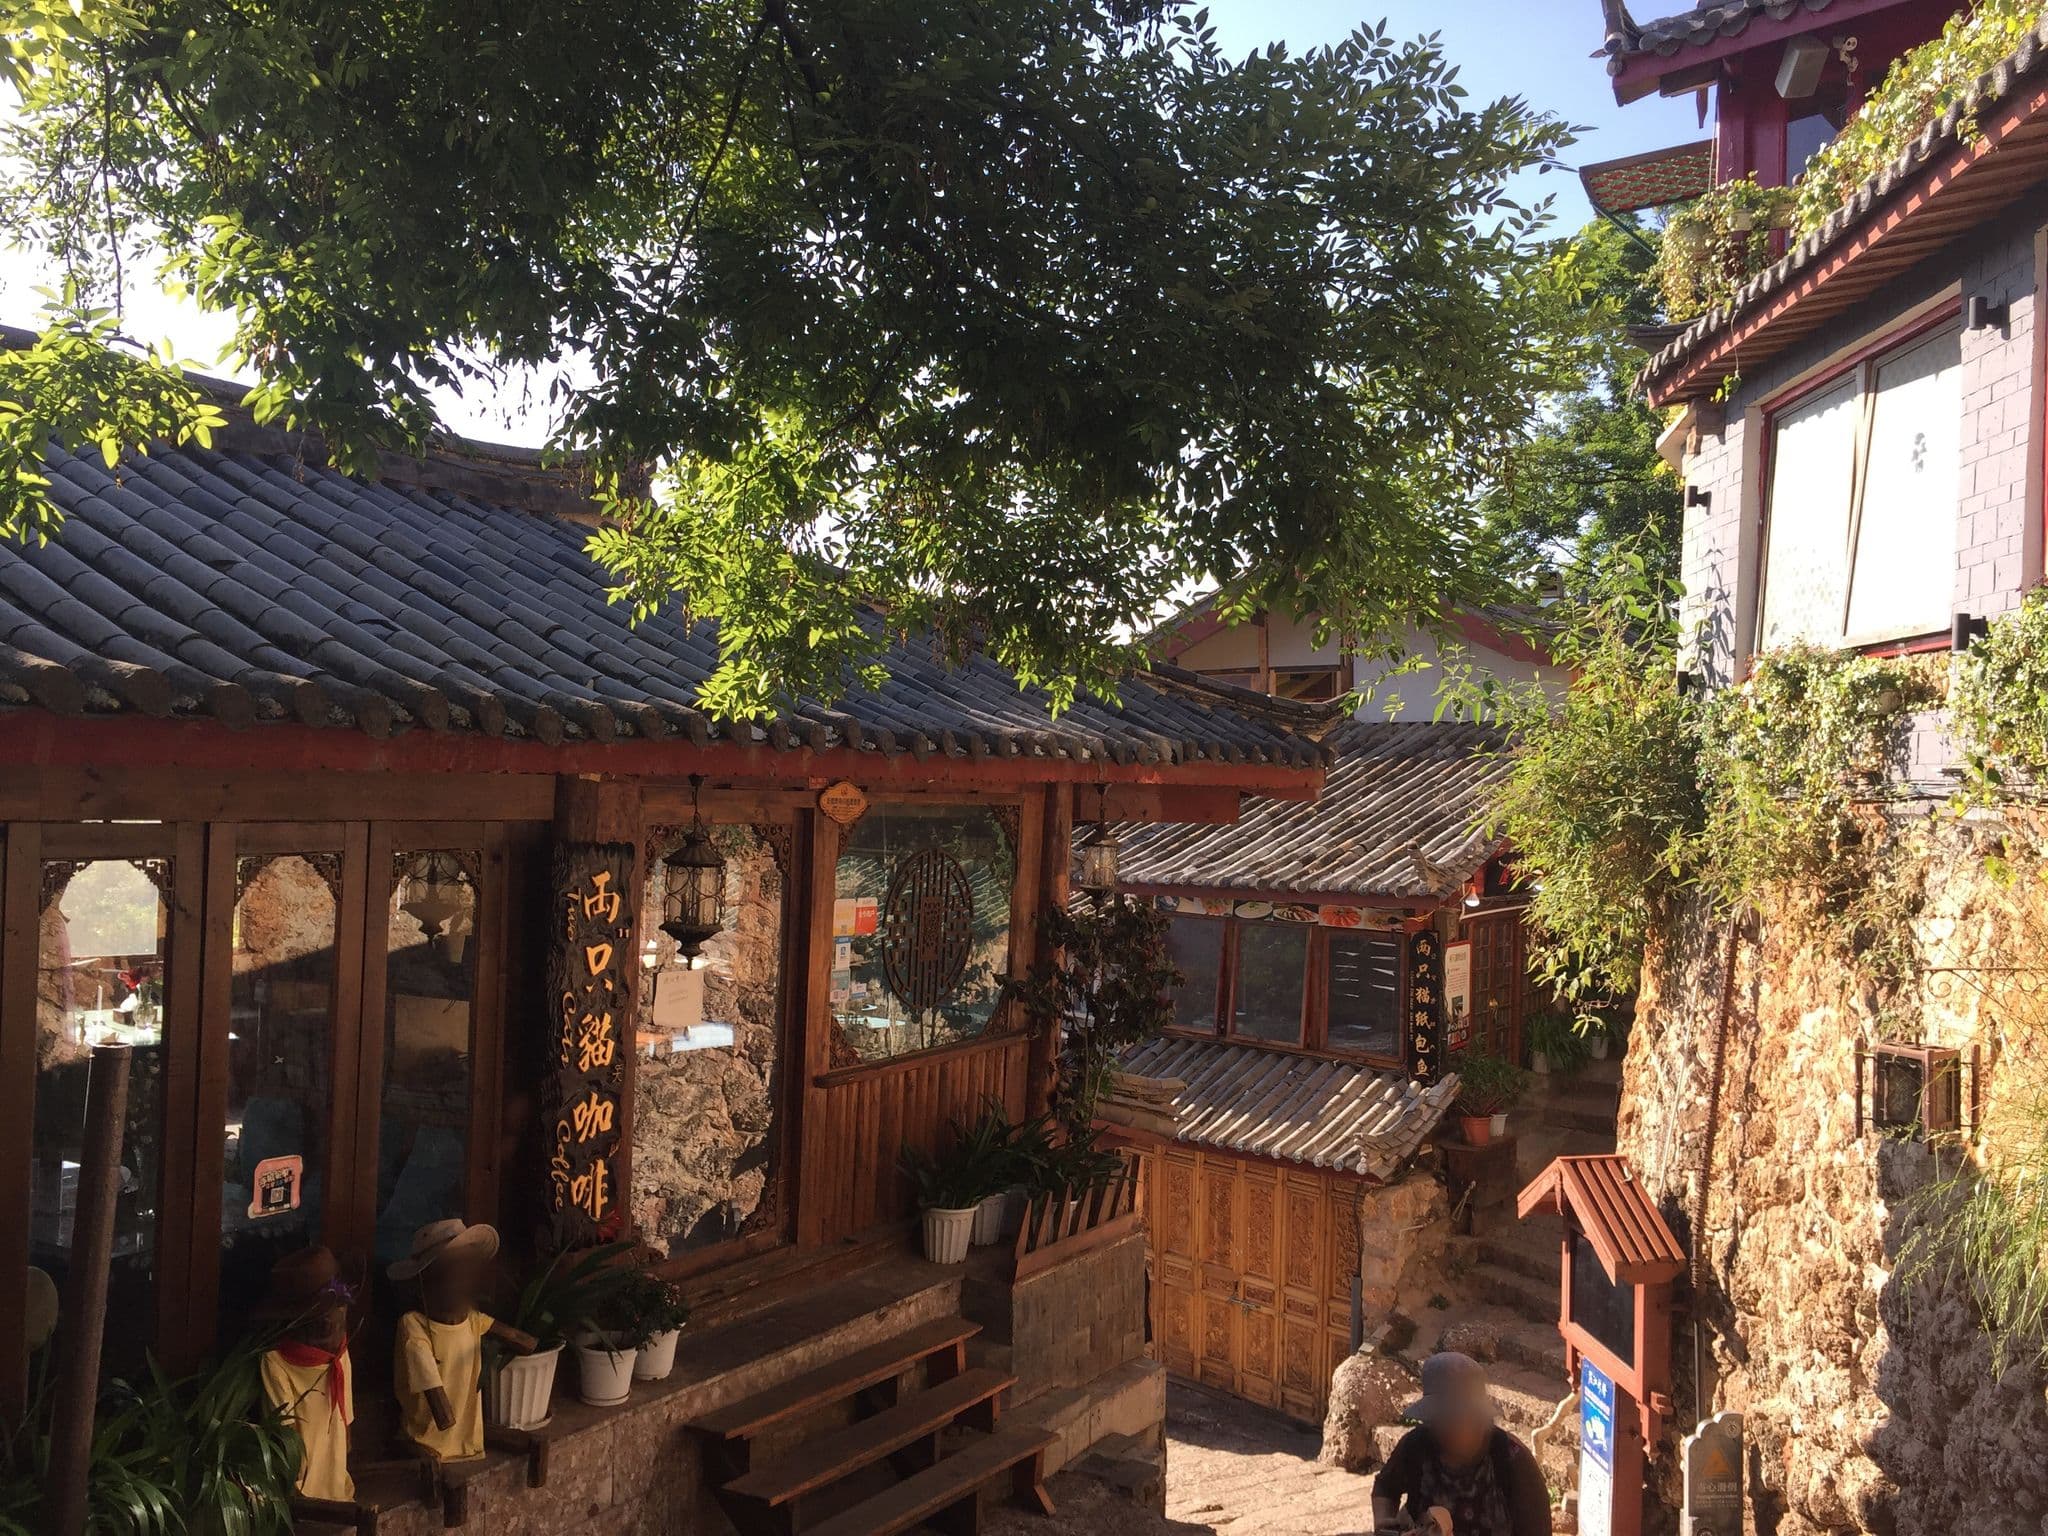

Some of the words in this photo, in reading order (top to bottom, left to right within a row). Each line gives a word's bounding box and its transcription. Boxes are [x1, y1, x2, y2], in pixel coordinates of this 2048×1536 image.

[566, 887, 581, 941] Two
[561, 991, 576, 1069] Cats
[551, 1119, 571, 1212] Coffee
